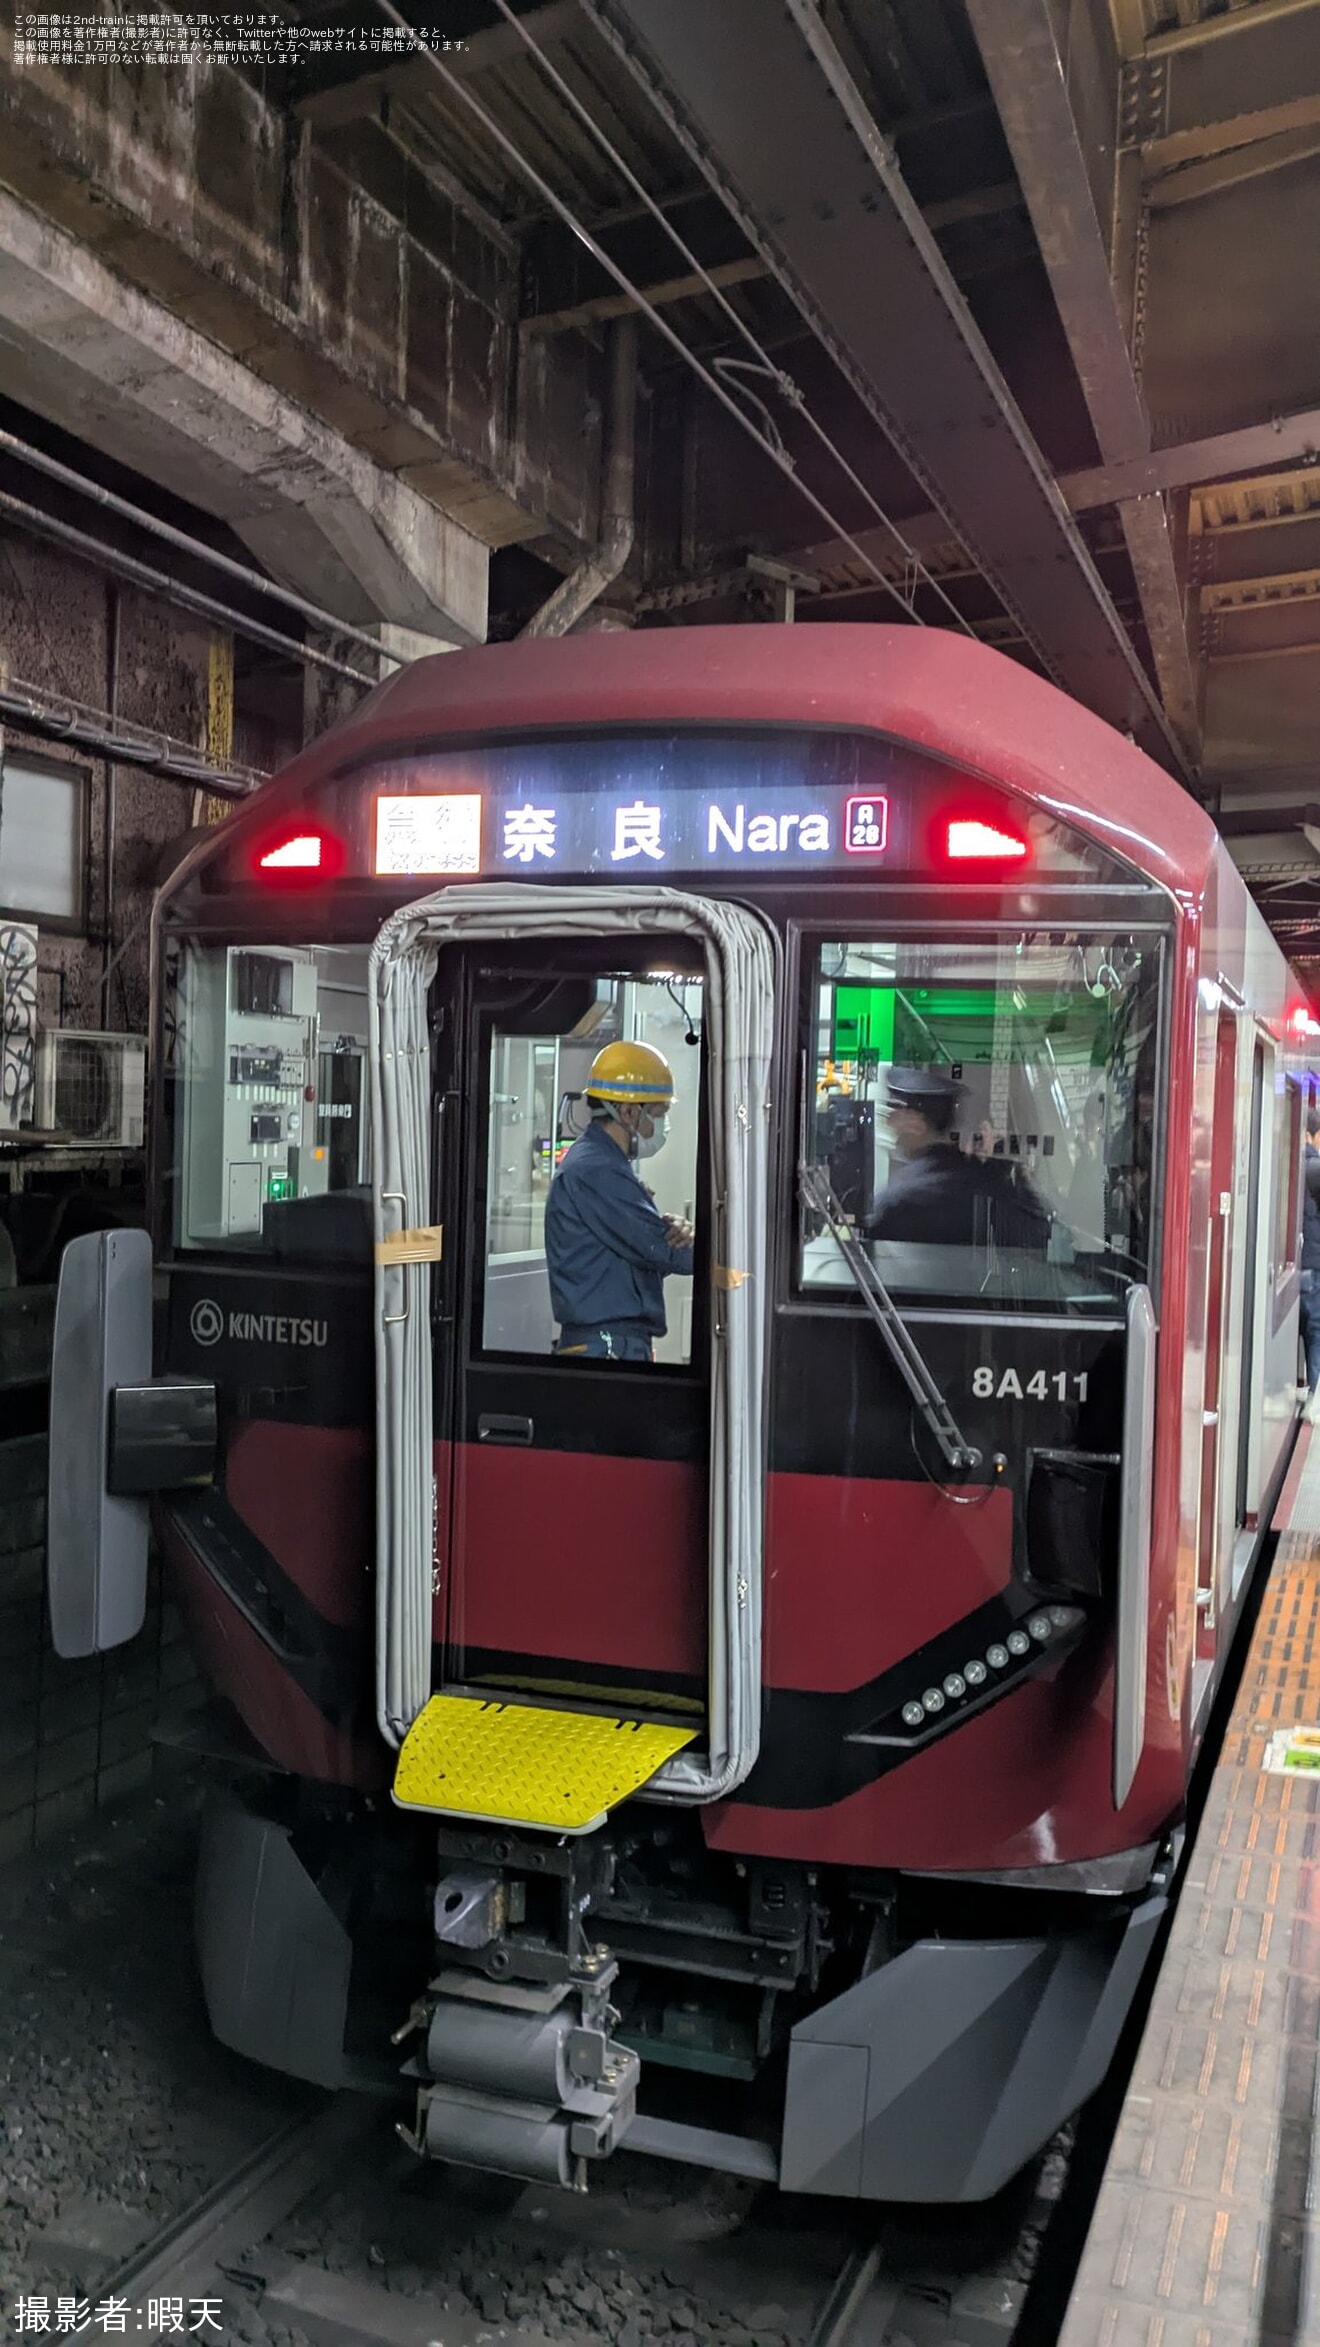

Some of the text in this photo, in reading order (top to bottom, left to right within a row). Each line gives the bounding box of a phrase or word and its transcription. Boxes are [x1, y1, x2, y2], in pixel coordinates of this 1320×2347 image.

[707, 804, 831, 853] Nara
[229, 1312, 328, 1346] KINTETSU
[972, 1366, 1088, 1402] 8A411
